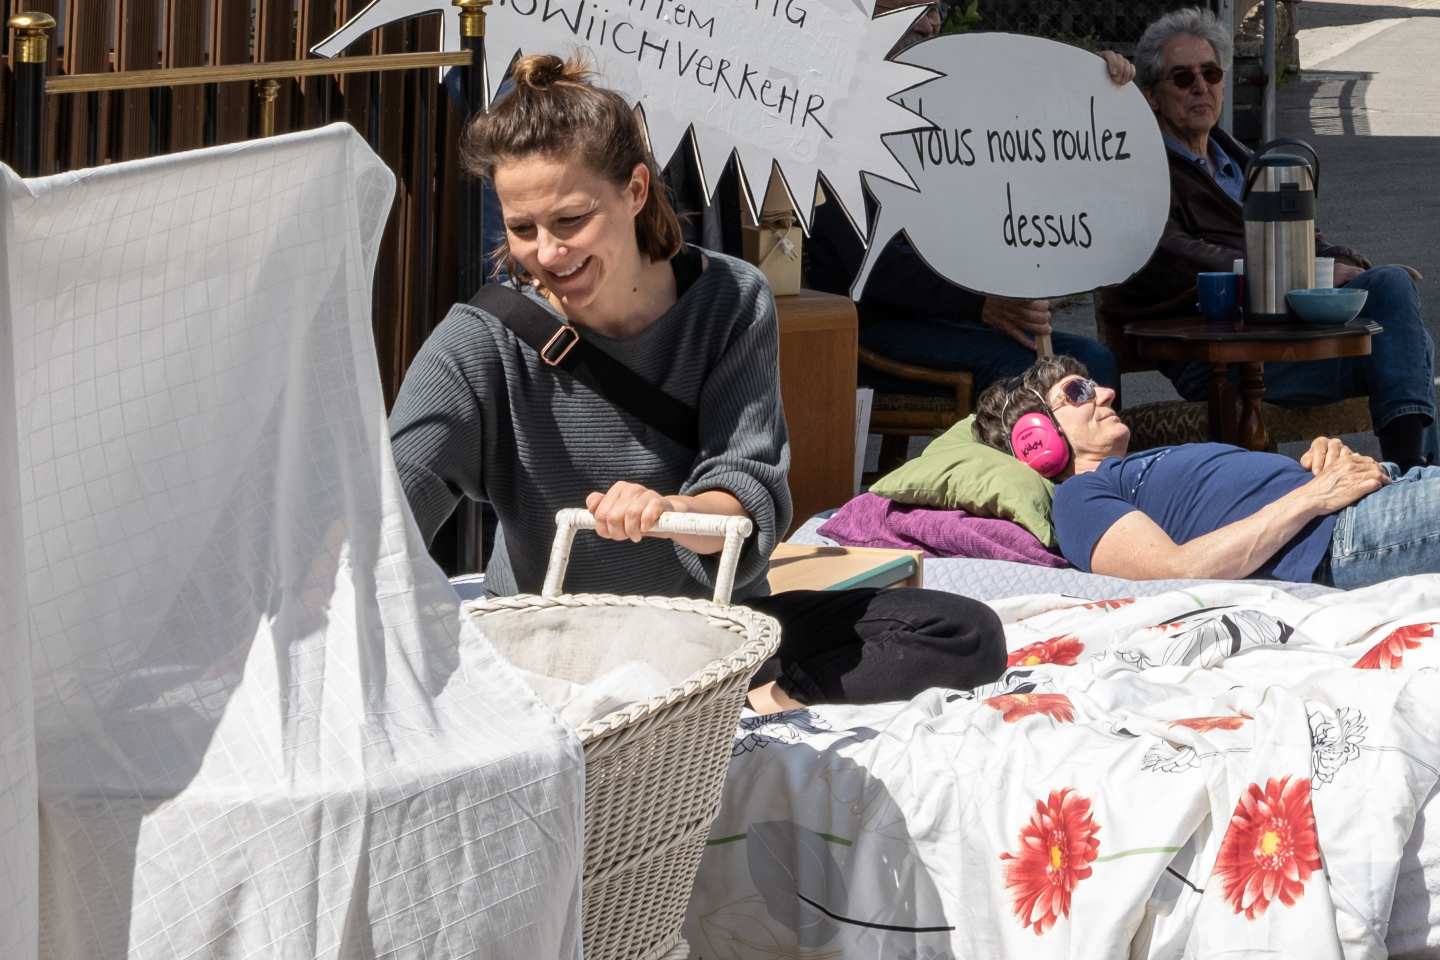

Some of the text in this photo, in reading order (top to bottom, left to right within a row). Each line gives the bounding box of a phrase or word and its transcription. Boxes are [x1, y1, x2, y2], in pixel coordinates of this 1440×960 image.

[986, 127, 1047, 164] nous
[1052, 95, 1132, 162] roulez
[1002, 181, 1093, 249] dessus
